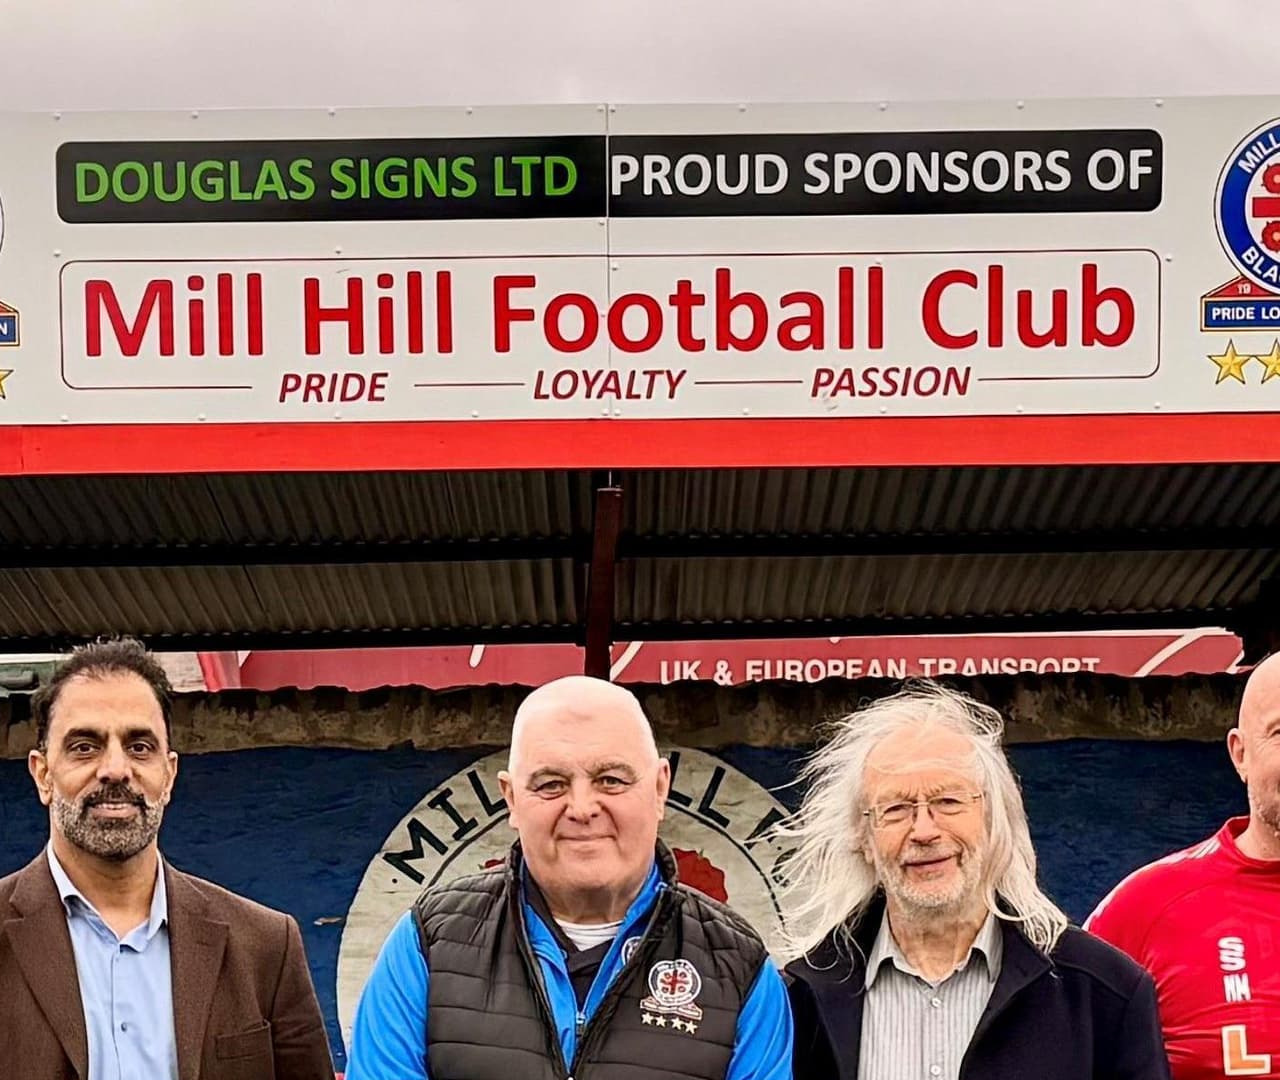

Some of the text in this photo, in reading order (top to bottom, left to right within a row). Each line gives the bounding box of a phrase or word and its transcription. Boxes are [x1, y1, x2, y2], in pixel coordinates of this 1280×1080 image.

[75, 149, 1153, 202] DOUGLAS SIGNS LTD PROUD SPONSORS OF
[85, 263, 1135, 357] Mill Hill Football Club
[1212, 307, 1255, 321] PRIDE
[279, 366, 972, 403] PRIDE LOYALTY PASSION
[660, 660, 701, 685] UK
[713, 659, 733, 686] &
[746, 658, 906, 682] EUROPEAN
